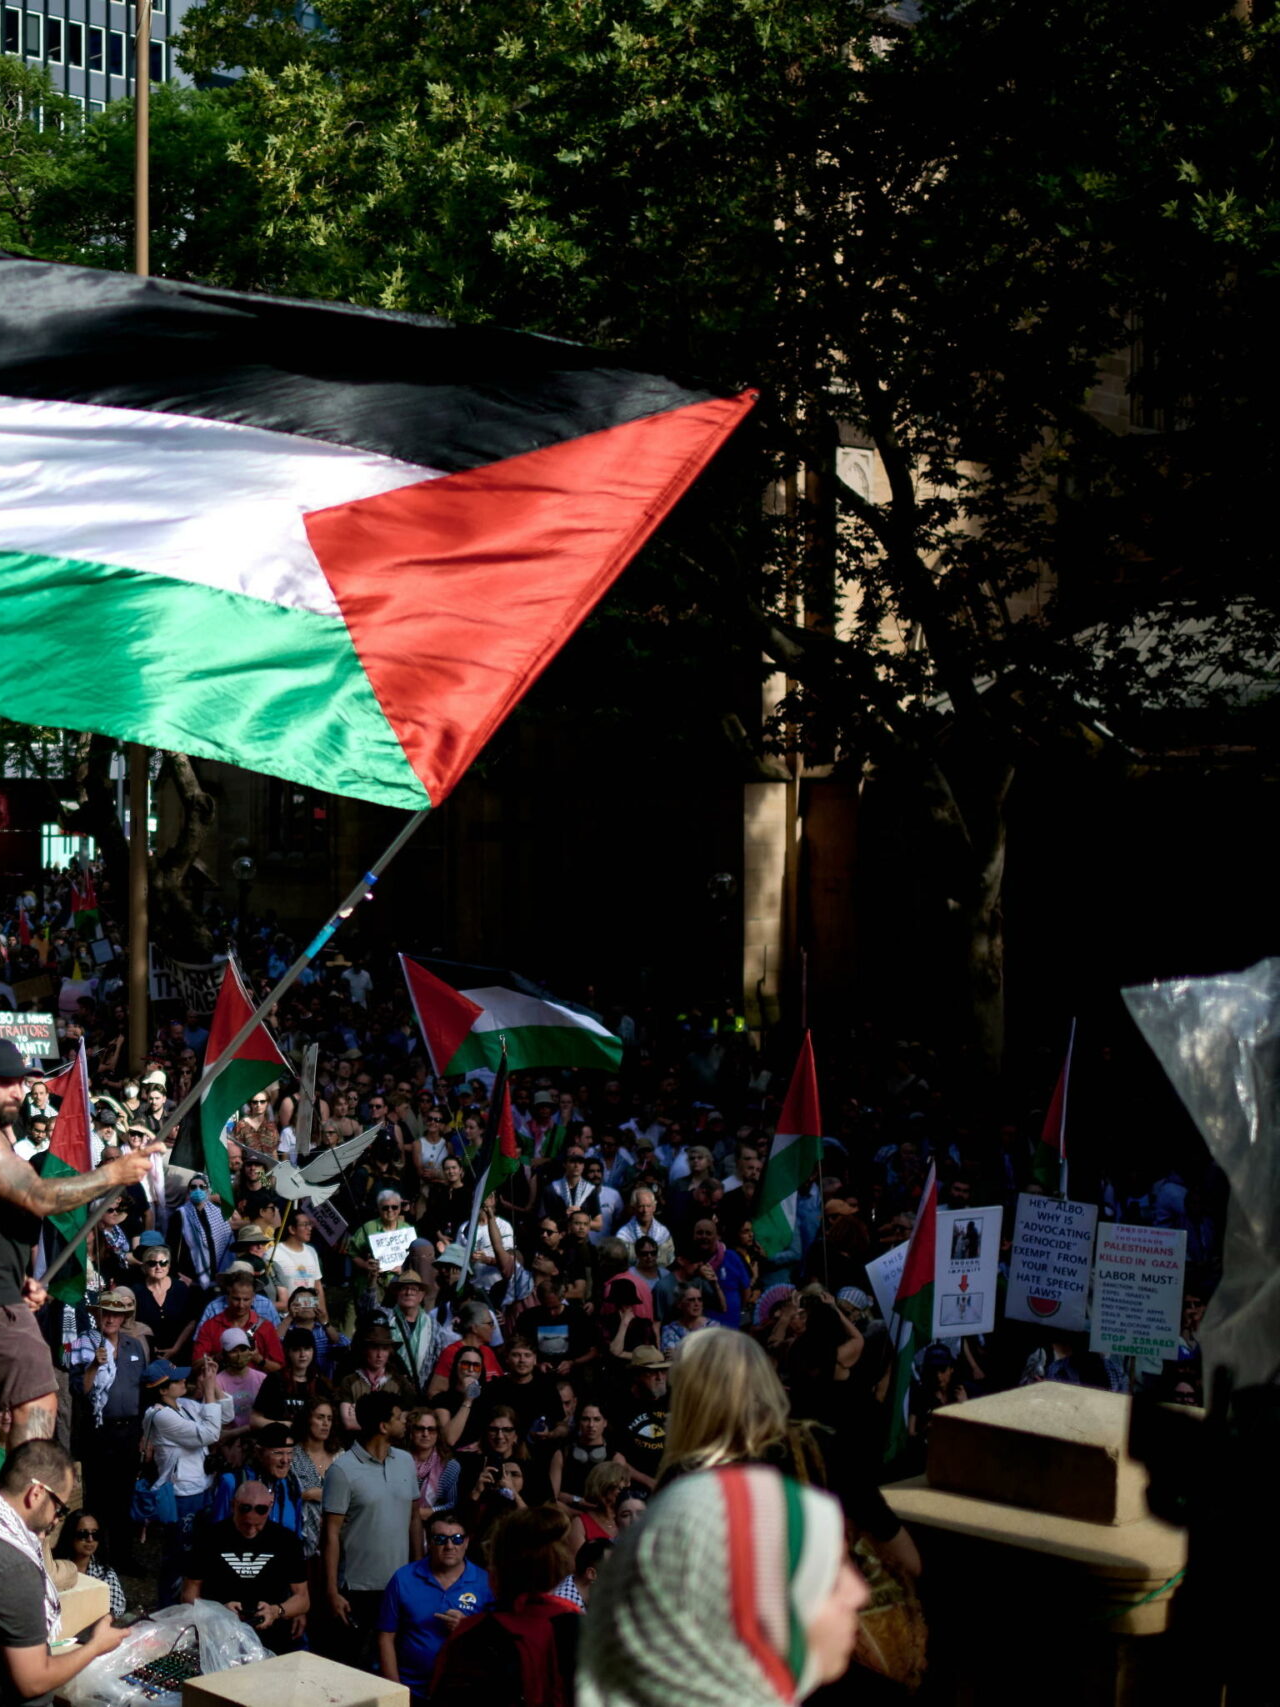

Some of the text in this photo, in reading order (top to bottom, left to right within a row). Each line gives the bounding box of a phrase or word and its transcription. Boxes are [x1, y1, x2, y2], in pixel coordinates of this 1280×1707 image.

[1030, 1199, 1084, 1216] HEY ALBO,
[1037, 1211, 1073, 1225] WHY IS
[1020, 1221, 1091, 1240] "ADVOCATING
[376, 1233, 408, 1247] RESPECT
[1022, 1234, 1077, 1250] GENOCIDE"
[1014, 1246, 1088, 1265] EXEMPT FROM
[1104, 1241, 1175, 1256] PALESTINIANS
[1022, 1260, 1078, 1277] YOUR NEW
[1099, 1253, 1179, 1269] KILLED IN GAZA
[1016, 1272, 1084, 1292] HATE SPEECH
[1099, 1270, 1178, 1285] LABOR MUST:
[1029, 1286, 1062, 1299] LAWS?
[1102, 1333, 1125, 1342] STOP
[1112, 1344, 1160, 1356] GENOCIDE!
